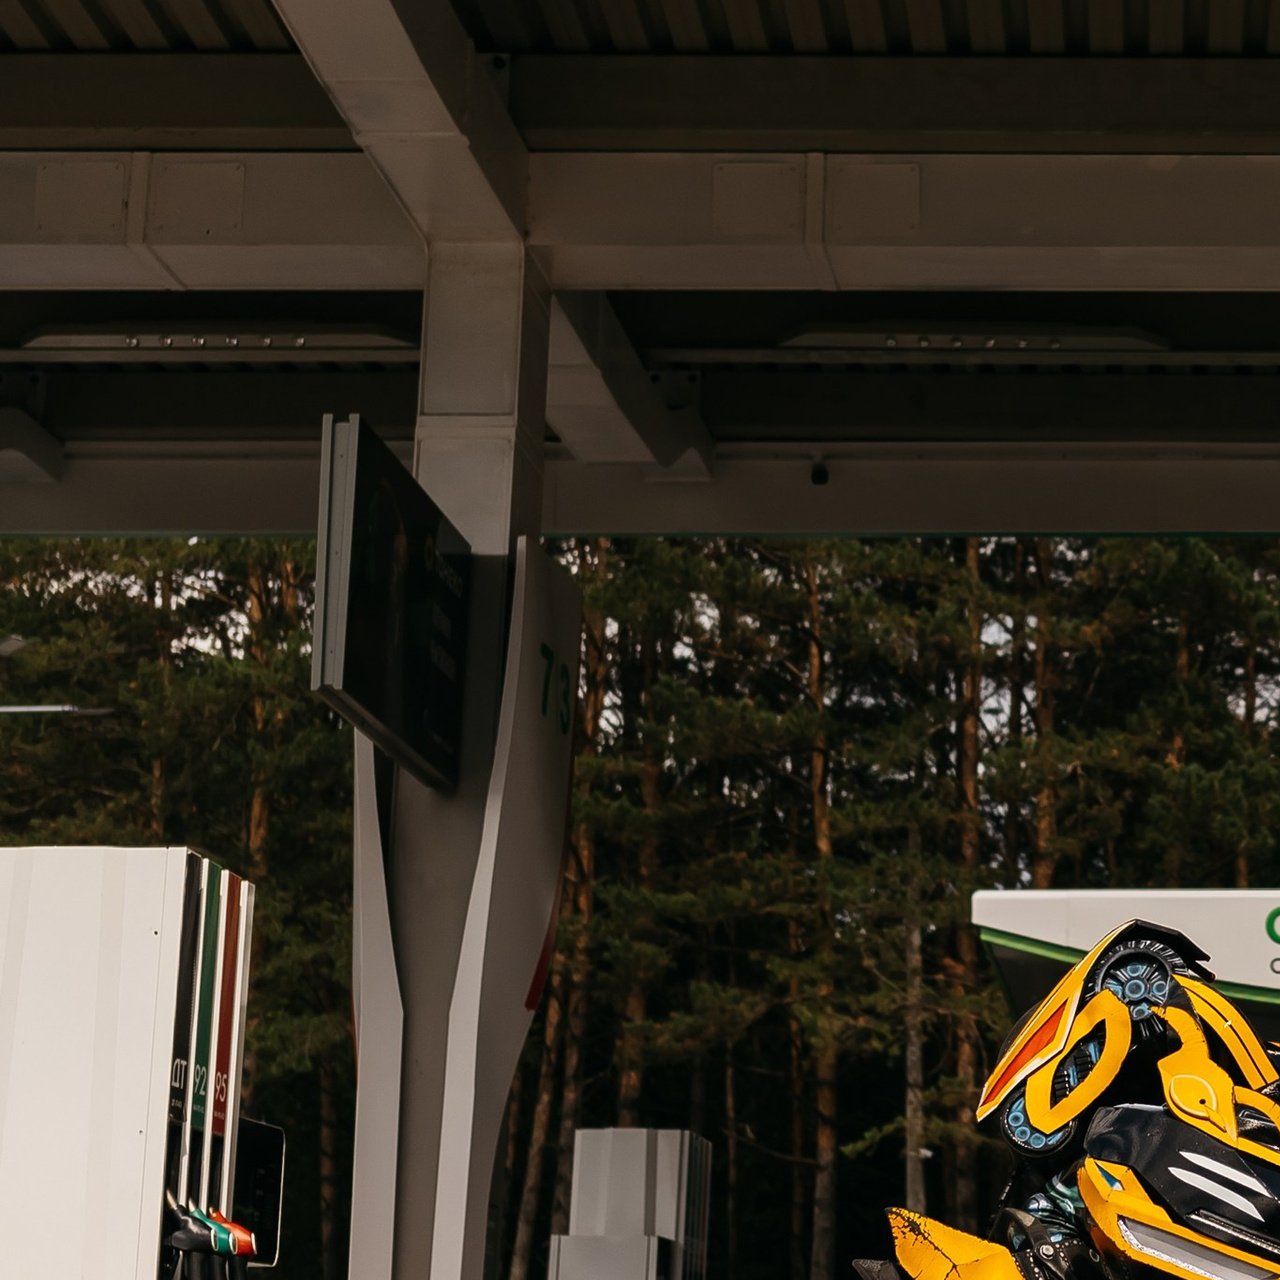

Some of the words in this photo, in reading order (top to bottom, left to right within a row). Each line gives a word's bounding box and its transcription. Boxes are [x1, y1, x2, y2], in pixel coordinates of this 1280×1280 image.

[540, 641, 570, 736] 73
[171, 1058, 187, 1089] ДТ
[194, 1064, 206, 1096] 92
[215, 1071, 228, 1102] 95
